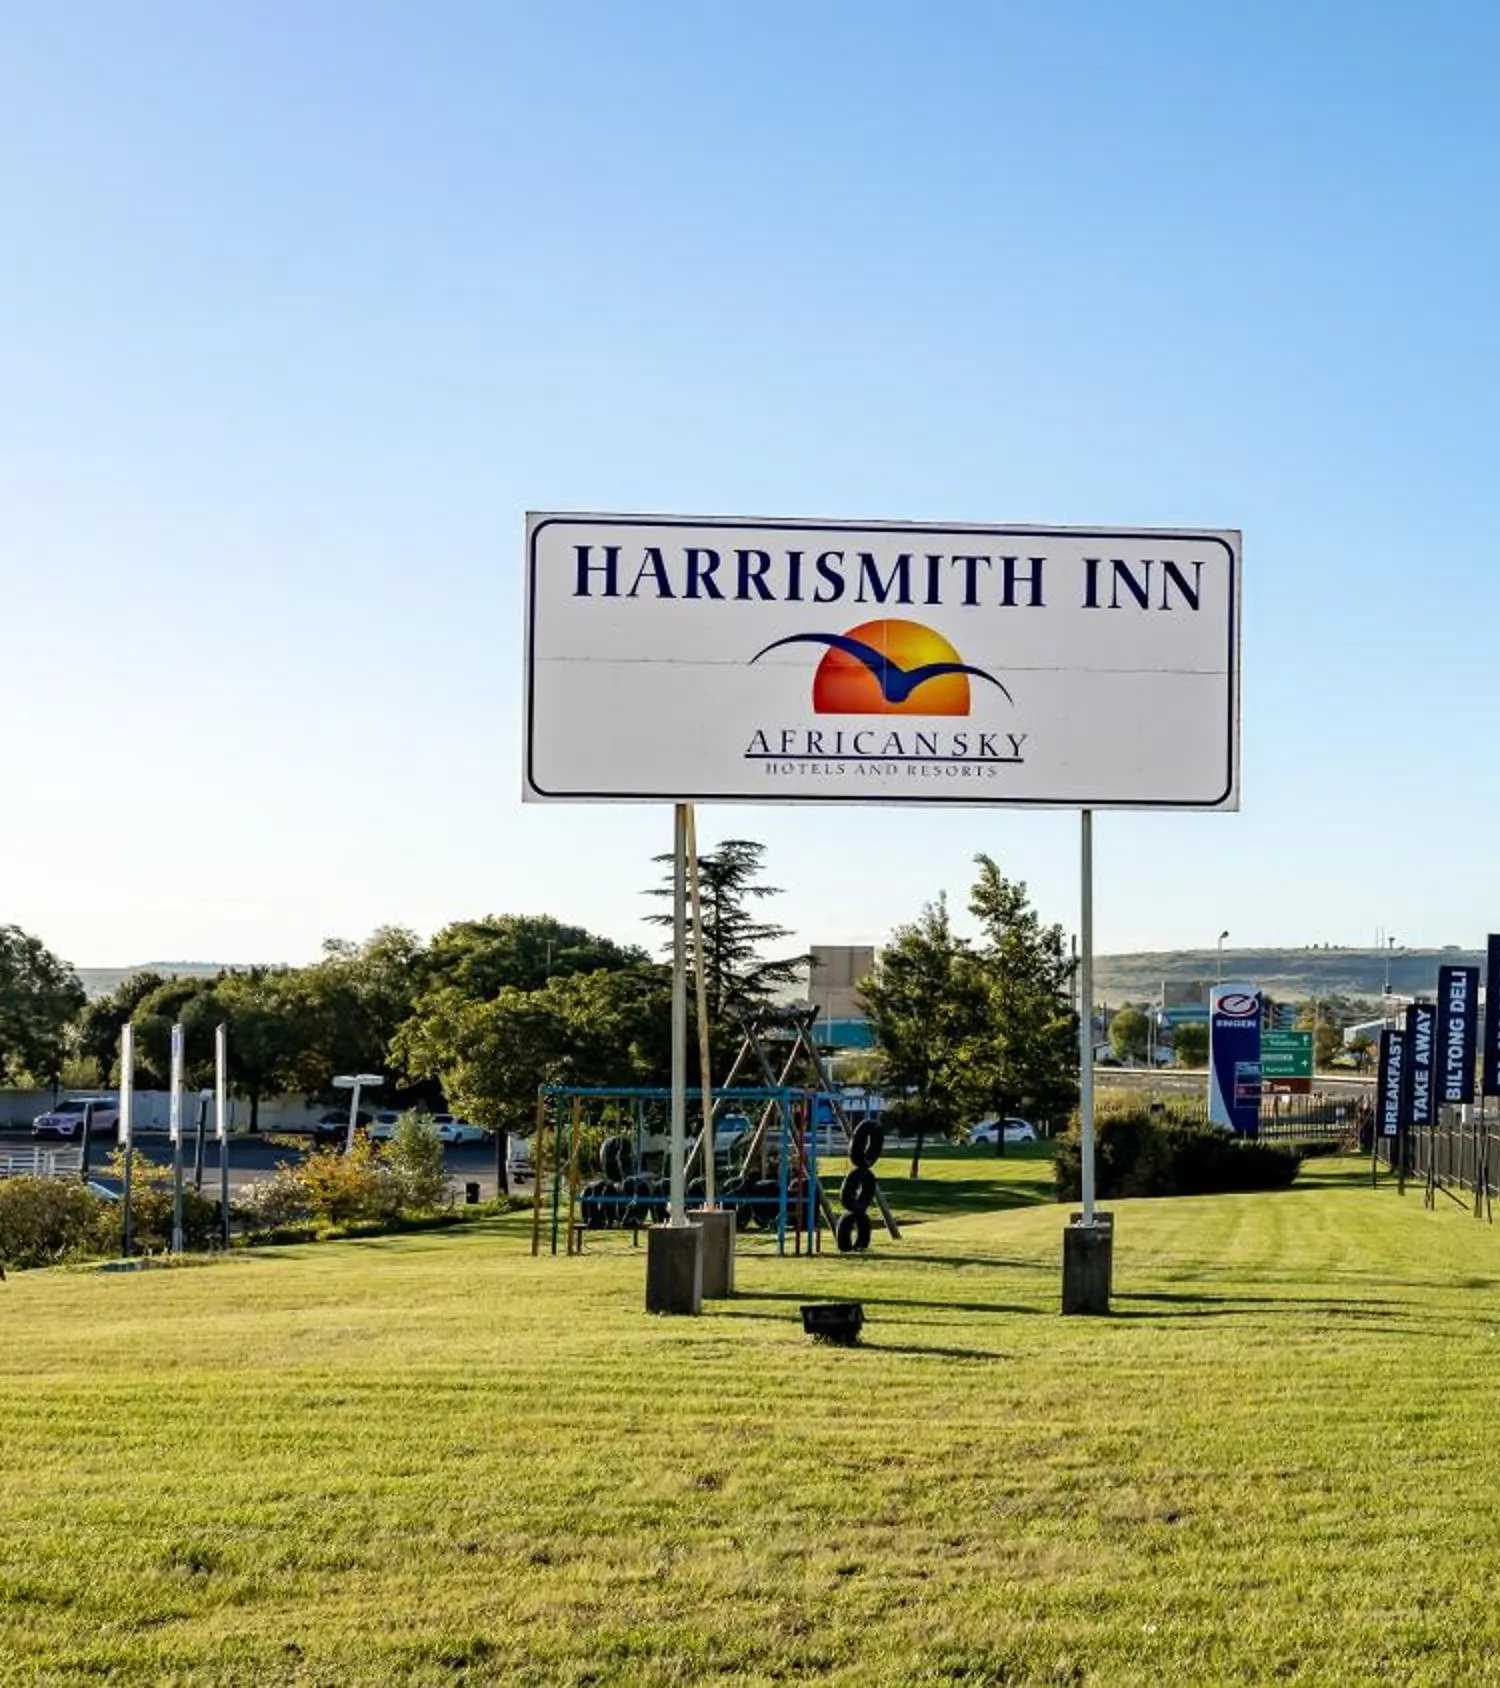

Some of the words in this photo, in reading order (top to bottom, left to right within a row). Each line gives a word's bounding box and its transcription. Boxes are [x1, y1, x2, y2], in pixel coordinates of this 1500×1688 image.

[573, 545, 1047, 608] HARRISMITH
[1081, 558, 1206, 611] INN
[765, 763, 845, 776] HOTELS
[854, 764, 898, 775] AND
[907, 765, 998, 778] RESORTS
[1450, 971, 1467, 1013] DELI
[1216, 1019, 1257, 1028] ENGEN
[1415, 1009, 1431, 1066] AWAY
[1384, 1033, 1403, 1135] BREAKFAST
[1446, 1017, 1465, 1101] BILTONG
[1413, 1069, 1429, 1122] TAKE
